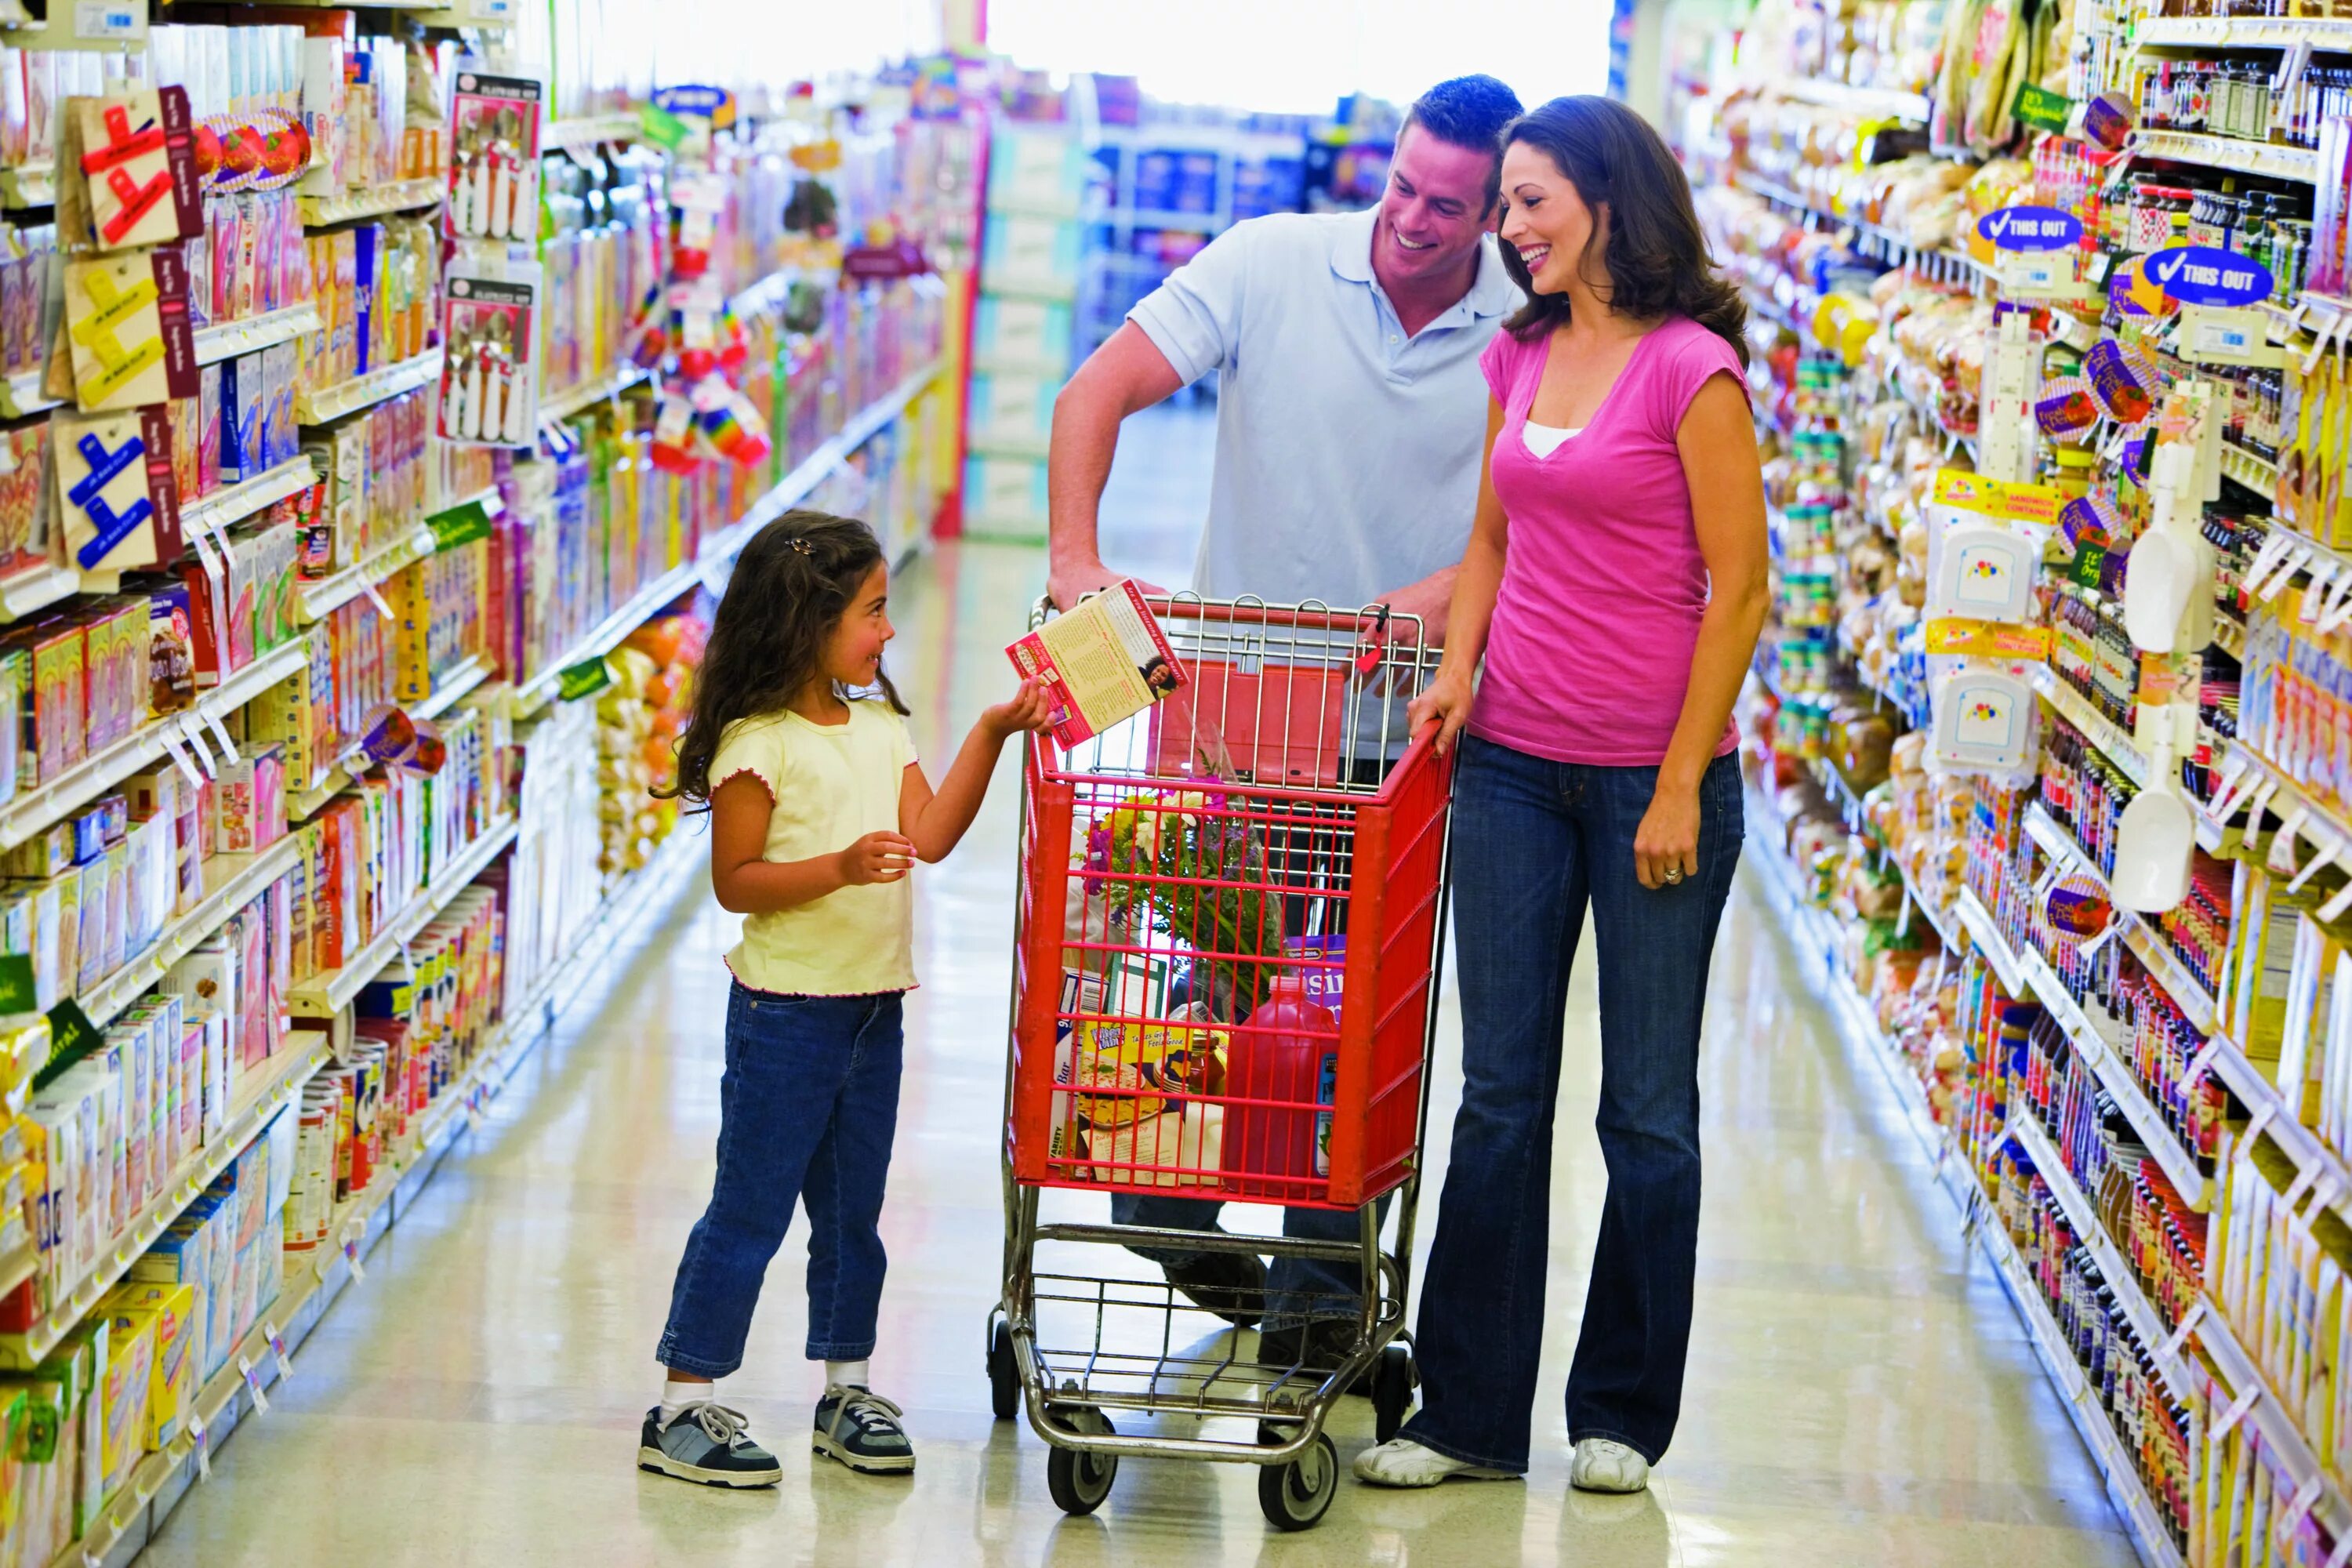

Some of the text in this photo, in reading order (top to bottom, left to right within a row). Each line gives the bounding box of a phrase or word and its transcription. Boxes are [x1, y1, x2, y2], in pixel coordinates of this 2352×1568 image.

[2009, 220, 2067, 237] THIS OUT
[2183, 263, 2256, 291] THIS OUT
[2039, 406, 2065, 422] Fresh
[1139, 609, 1158, 637] listening
[1167, 659, 1183, 682] heart?
[2051, 898, 2074, 912] Fresh
[1057, 1062, 1071, 1085] Bar
